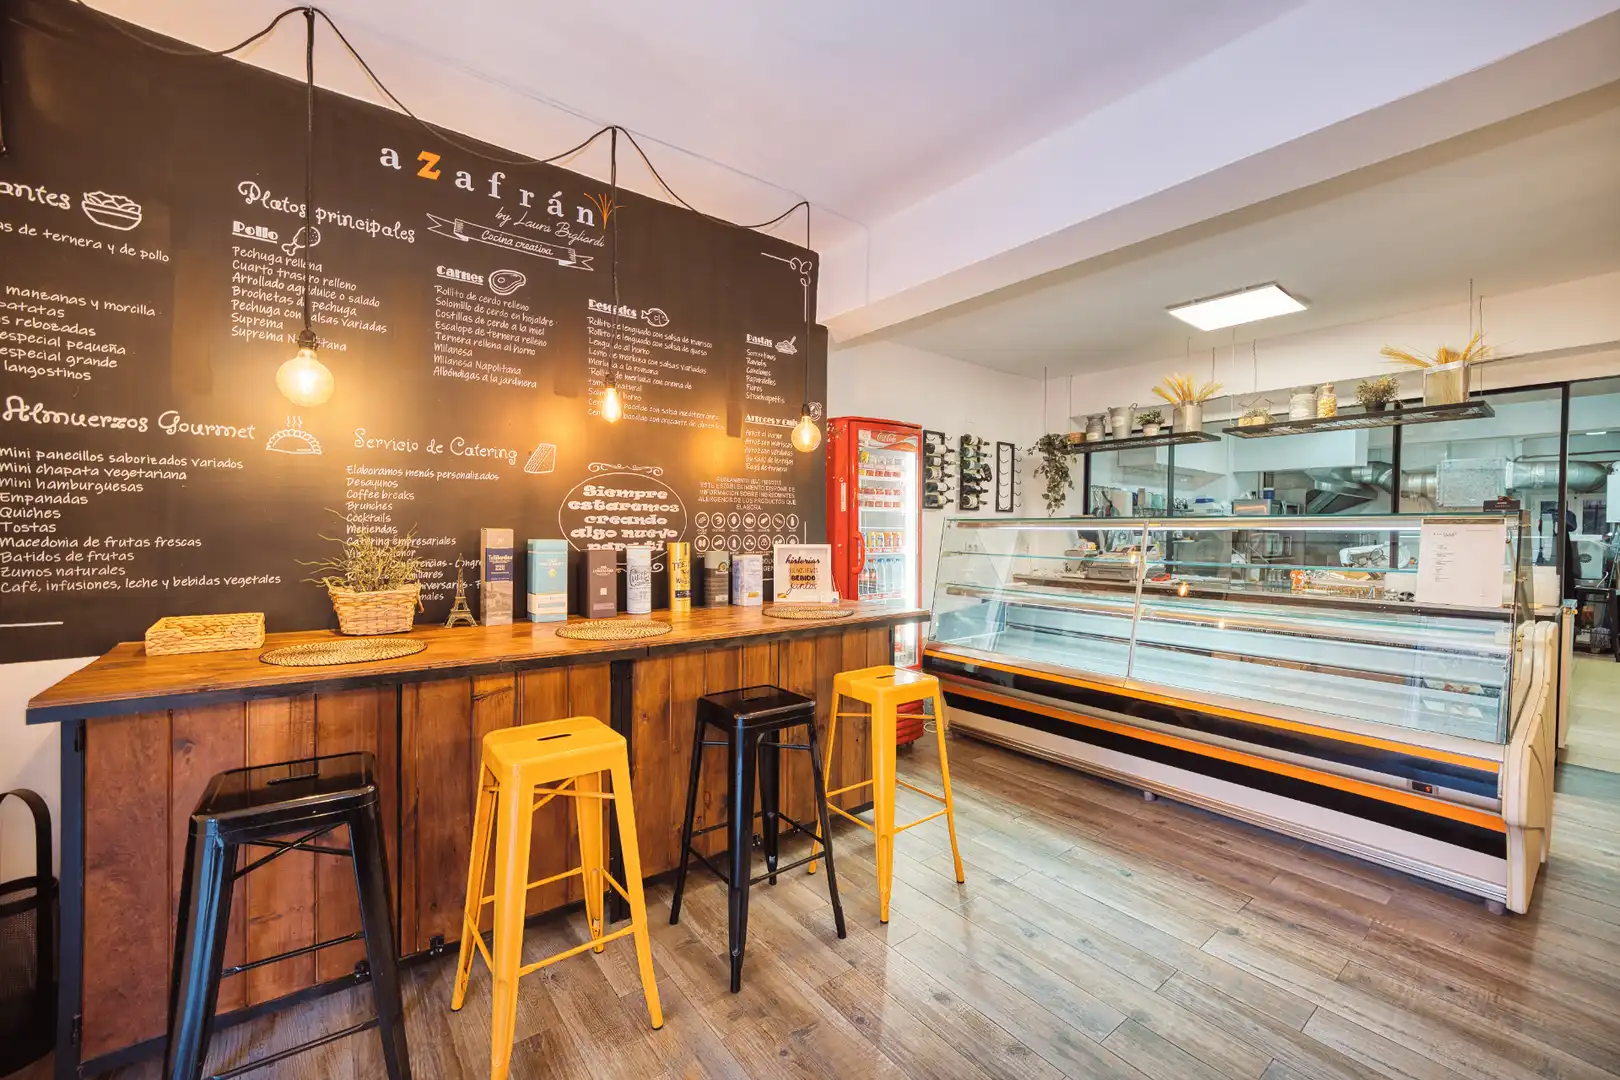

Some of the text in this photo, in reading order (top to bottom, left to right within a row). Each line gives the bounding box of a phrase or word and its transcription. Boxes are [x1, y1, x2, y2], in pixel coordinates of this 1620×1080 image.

[238, 181, 415, 243] Platos principales
[232, 221, 278, 240] Pollo
[495, 207, 604, 247] by Laura Bigliardi
[19, 224, 37, 237] de
[43, 229, 102, 249] ternera
[108, 243, 114, 254] y
[119, 243, 136, 256] de
[140, 249, 169, 262] pollo
[481, 230, 554, 256] Cocina creativa
[232, 246, 282, 265] Pechuga
[233, 260, 272, 275] Cuarto
[323, 279, 356, 291] relleno
[437, 266, 484, 283] Carnes
[232, 273, 284, 290] Arrollado
[349, 295, 380, 307] salado
[434, 285, 529, 312] Rollito de cerdo relleno
[6, 285, 155, 316] manzanas y morcilla
[232, 285, 357, 316] Brochetas pechuga
[231, 299, 387, 333] Pechuga con alsas variadas
[231, 312, 284, 329] Suprema
[436, 297, 472, 311] Solomillo
[474, 304, 484, 313] de
[486, 306, 508, 318] cerdo
[522, 312, 554, 327] hojaldre
[16, 316, 96, 336] rebozadas
[436, 309, 472, 323] Costillas
[475, 316, 485, 325] de
[487, 319, 509, 329] cerdo
[519, 322, 526, 332] la
[529, 328, 544, 336] miel
[0, 330, 126, 355] especial pequeña
[231, 326, 283, 342] Suprema
[435, 332, 471, 345] Ternera
[474, 338, 501, 350] rellena
[504, 343, 512, 352] al
[436, 321, 547, 347] Escalope de ternera relleno
[0, 346, 117, 368] especial grande
[434, 342, 472, 356] Milanesa
[4, 360, 91, 380] langostinos
[433, 366, 480, 381] Albóndigas
[490, 374, 498, 382] la
[434, 354, 521, 375] Milanesa Napolitana
[2, 395, 255, 439] Almuerzos Gourmet
[354, 427, 517, 465] Servicio de Catering
[0, 447, 243, 469] Mini panecillos saborizados variados
[0, 462, 186, 481] Mini chapata vegetariana
[346, 464, 499, 481] Elaboramos menús personalizados
[0, 477, 144, 494] Mini hamburguesas
[346, 477, 398, 489] Desayunos
[583, 485, 668, 500] Siempre
[0, 492, 88, 505] Empanadas
[346, 489, 414, 501] Coffee breaks
[0, 507, 61, 520] Quiches
[346, 501, 393, 511] Brunches
[568, 500, 679, 512] estaremos
[346, 512, 391, 523] Cocktails
[584, 515, 668, 526] creando
[0, 522, 56, 533] Tostas
[571, 526, 678, 540] algo nuevo
[0, 536, 202, 548] Macedonia de frutas frescas
[587, 542, 639, 551] par
[0, 550, 134, 563] Batidos de frutas
[1, 565, 126, 578] Zumos naturales
[1, 574, 281, 593] Café, infusiones, leche y bebidas vegetales
